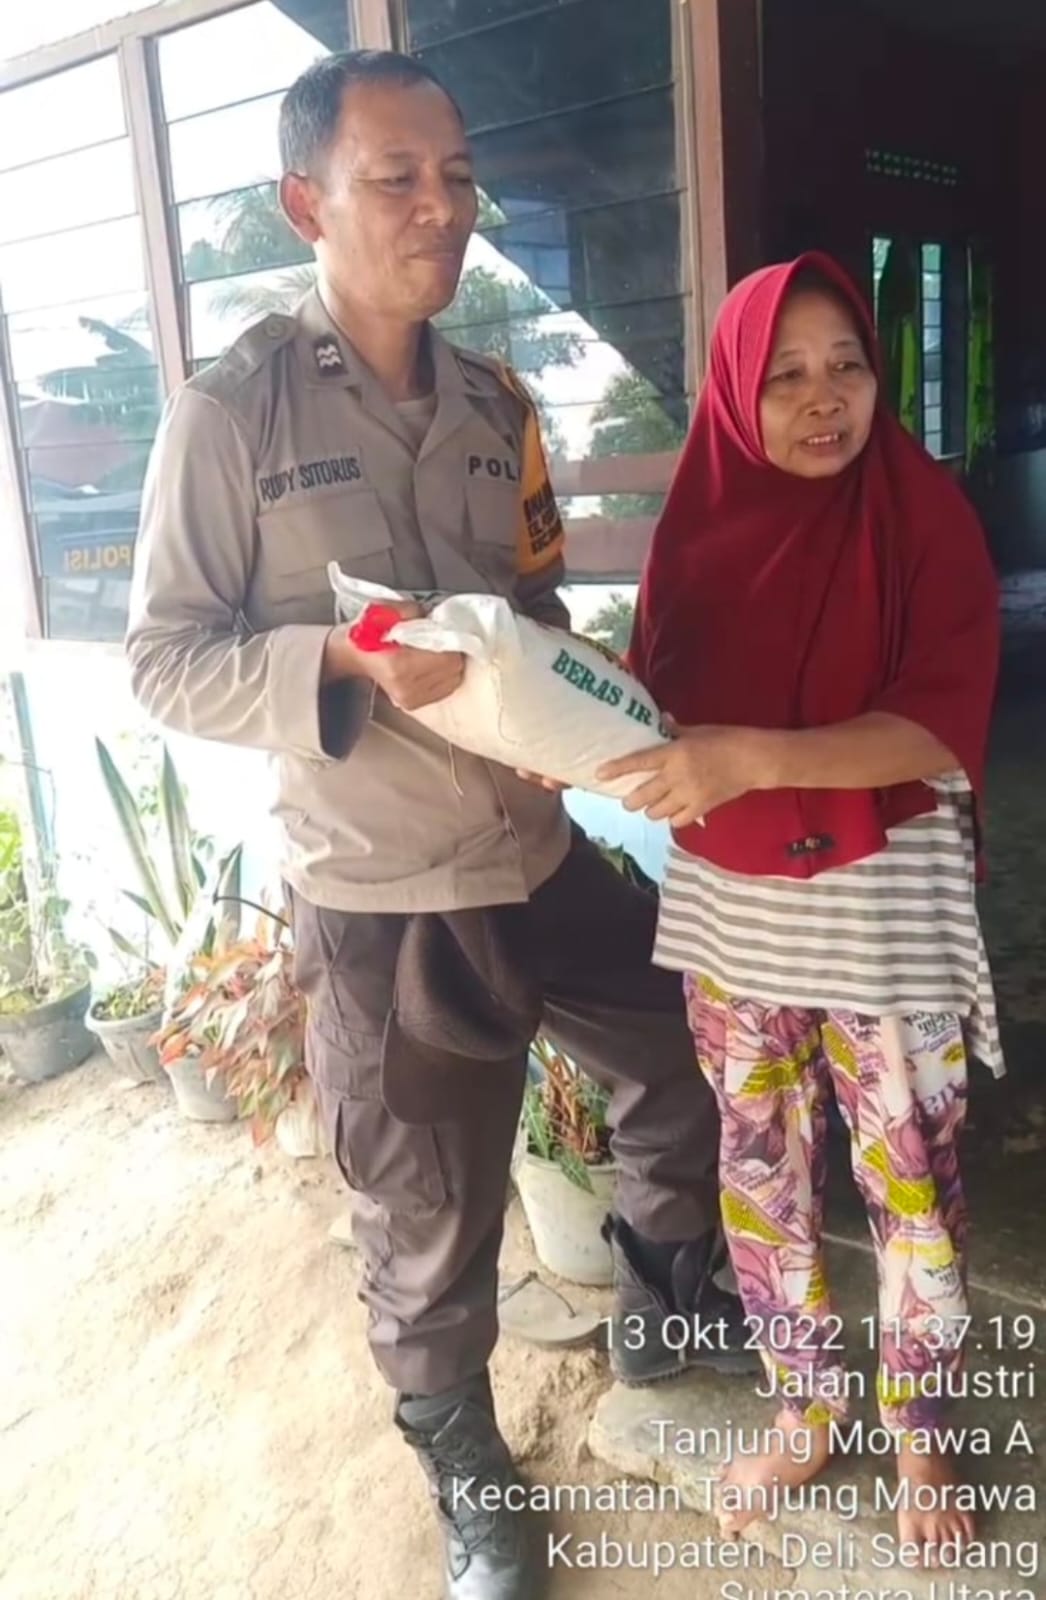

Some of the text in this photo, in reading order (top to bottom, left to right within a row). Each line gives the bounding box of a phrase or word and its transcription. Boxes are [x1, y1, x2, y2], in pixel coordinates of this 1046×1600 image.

[298, 457, 361, 489] SITORUS
[552, 648, 652, 727] BERAS IR
